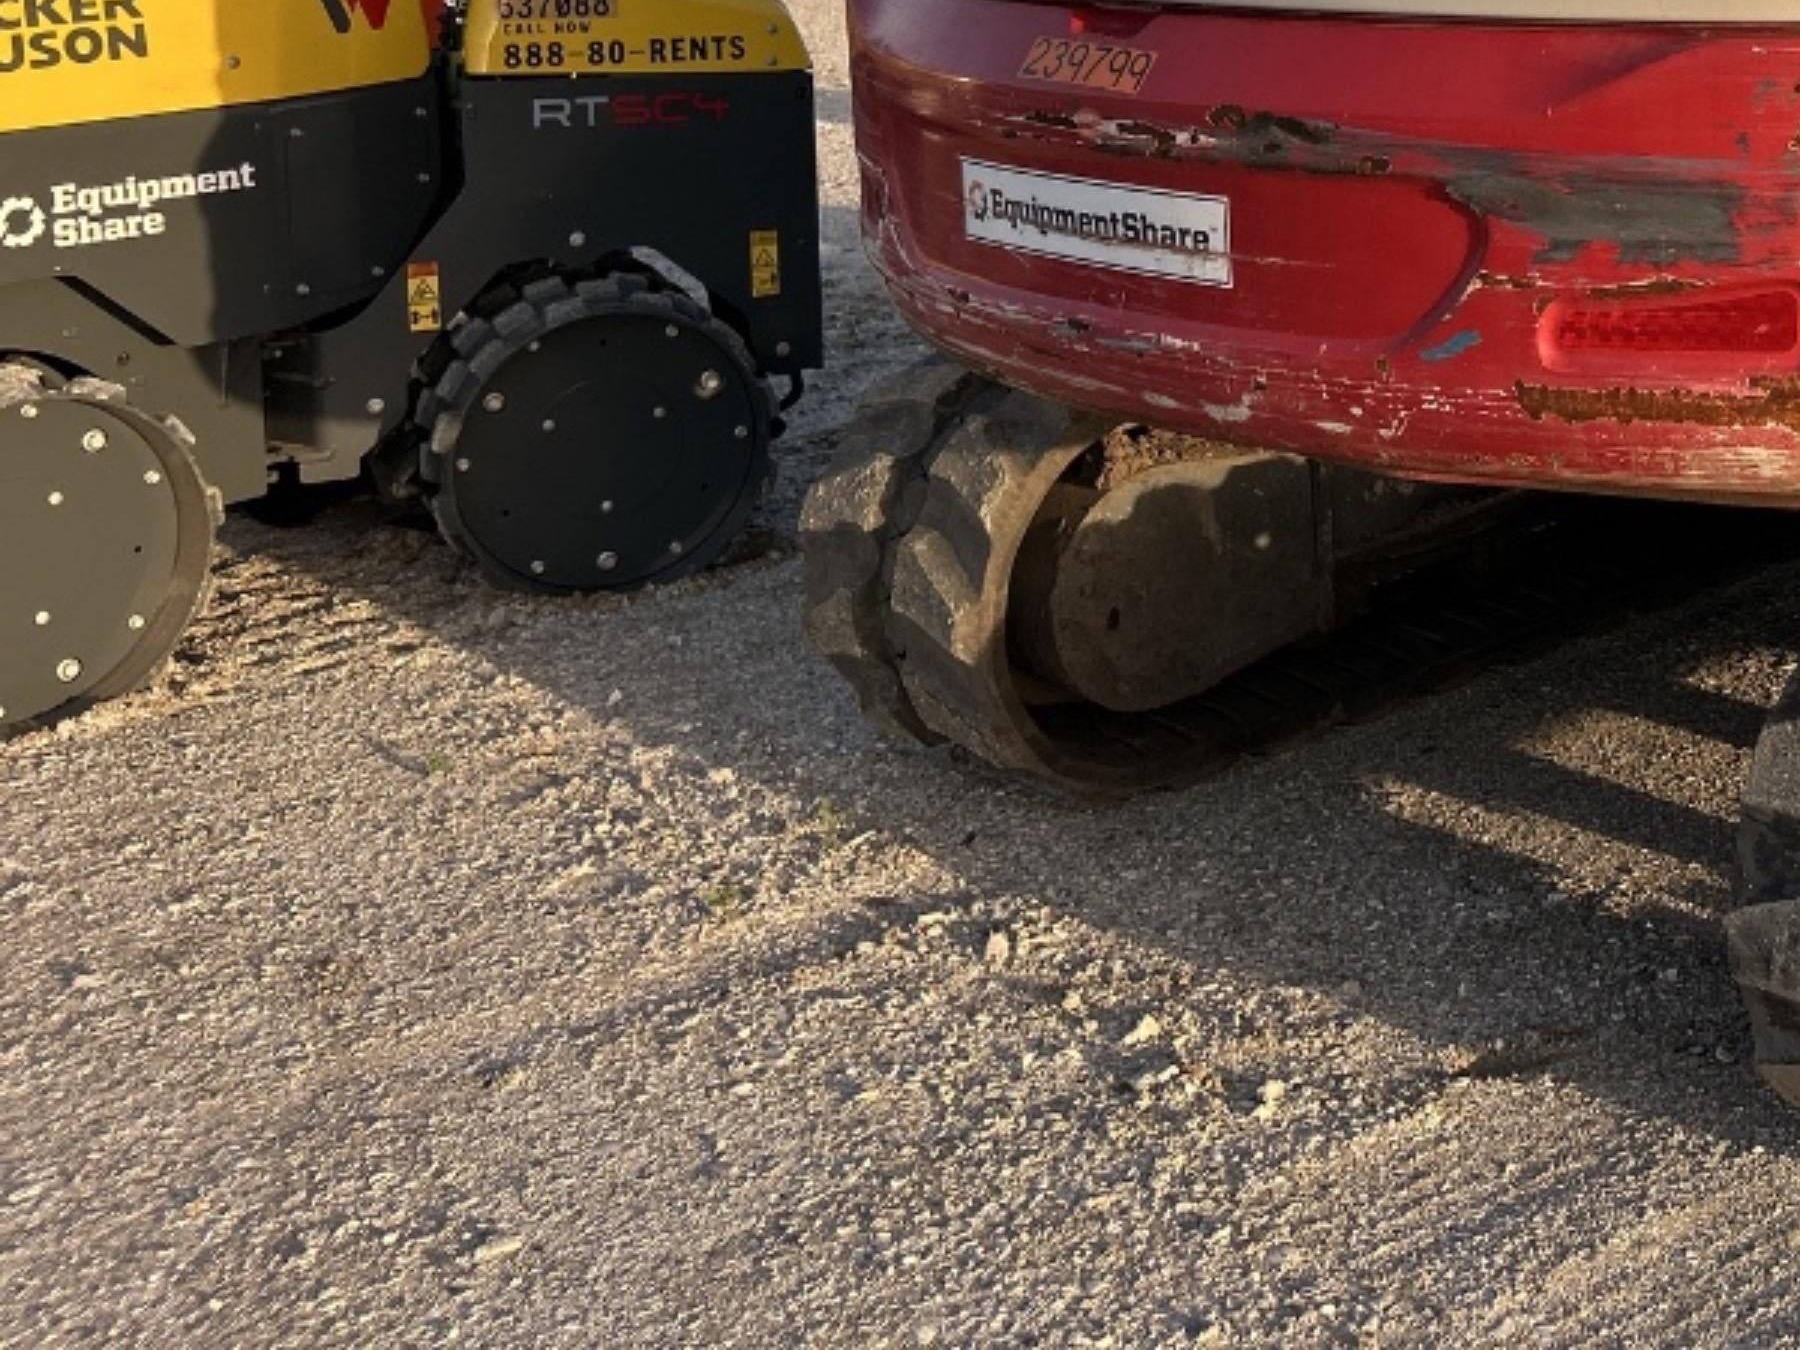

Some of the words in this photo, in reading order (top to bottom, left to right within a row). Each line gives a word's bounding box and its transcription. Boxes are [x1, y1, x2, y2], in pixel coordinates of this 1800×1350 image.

[503, 22, 545, 35] CALL
[554, 20, 592, 34] NOW
[504, 35, 745, 68] 888-80-RENTS
[1022, 38, 1150, 90] 239799
[51, 161, 256, 216] Equipment
[53, 211, 166, 247] Share
[989, 188, 1210, 251] EquipmentShare
